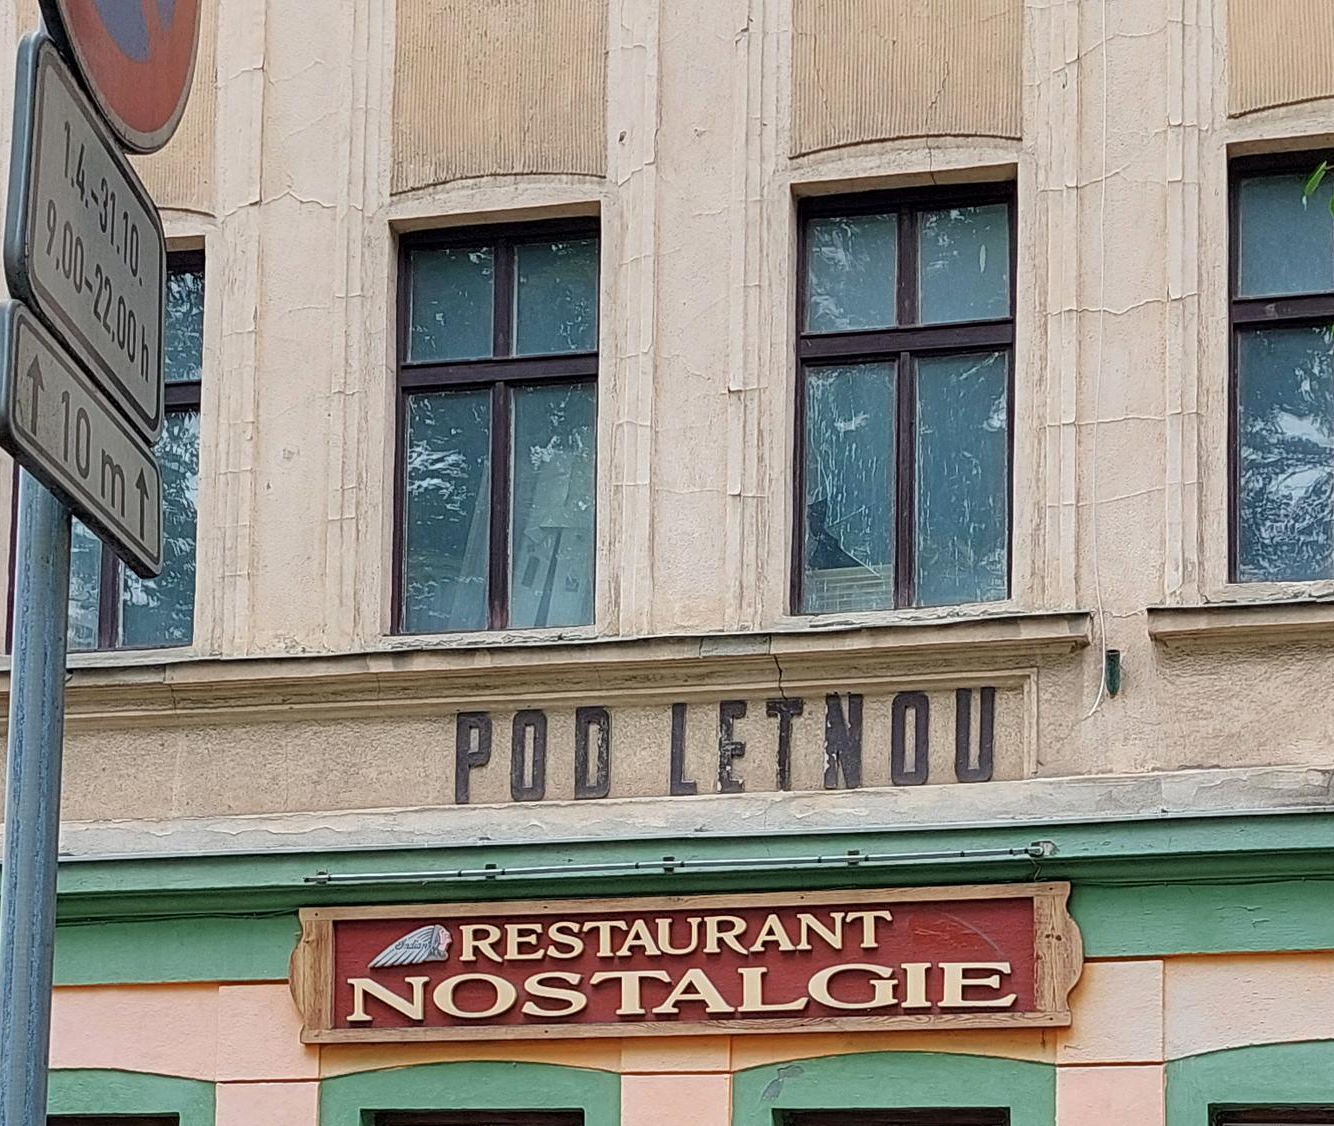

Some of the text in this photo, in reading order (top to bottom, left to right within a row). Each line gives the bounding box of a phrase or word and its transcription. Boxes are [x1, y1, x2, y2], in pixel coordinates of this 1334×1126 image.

[64, 120, 143, 287] 1.4.-31.10.
[140, 323, 149, 384] h
[61, 390, 126, 518] 10 m
[455, 686, 997, 803] POD LETNOU
[458, 909, 895, 963] RESTAURANT
[346, 961, 1018, 1023] NOSTALGIE
